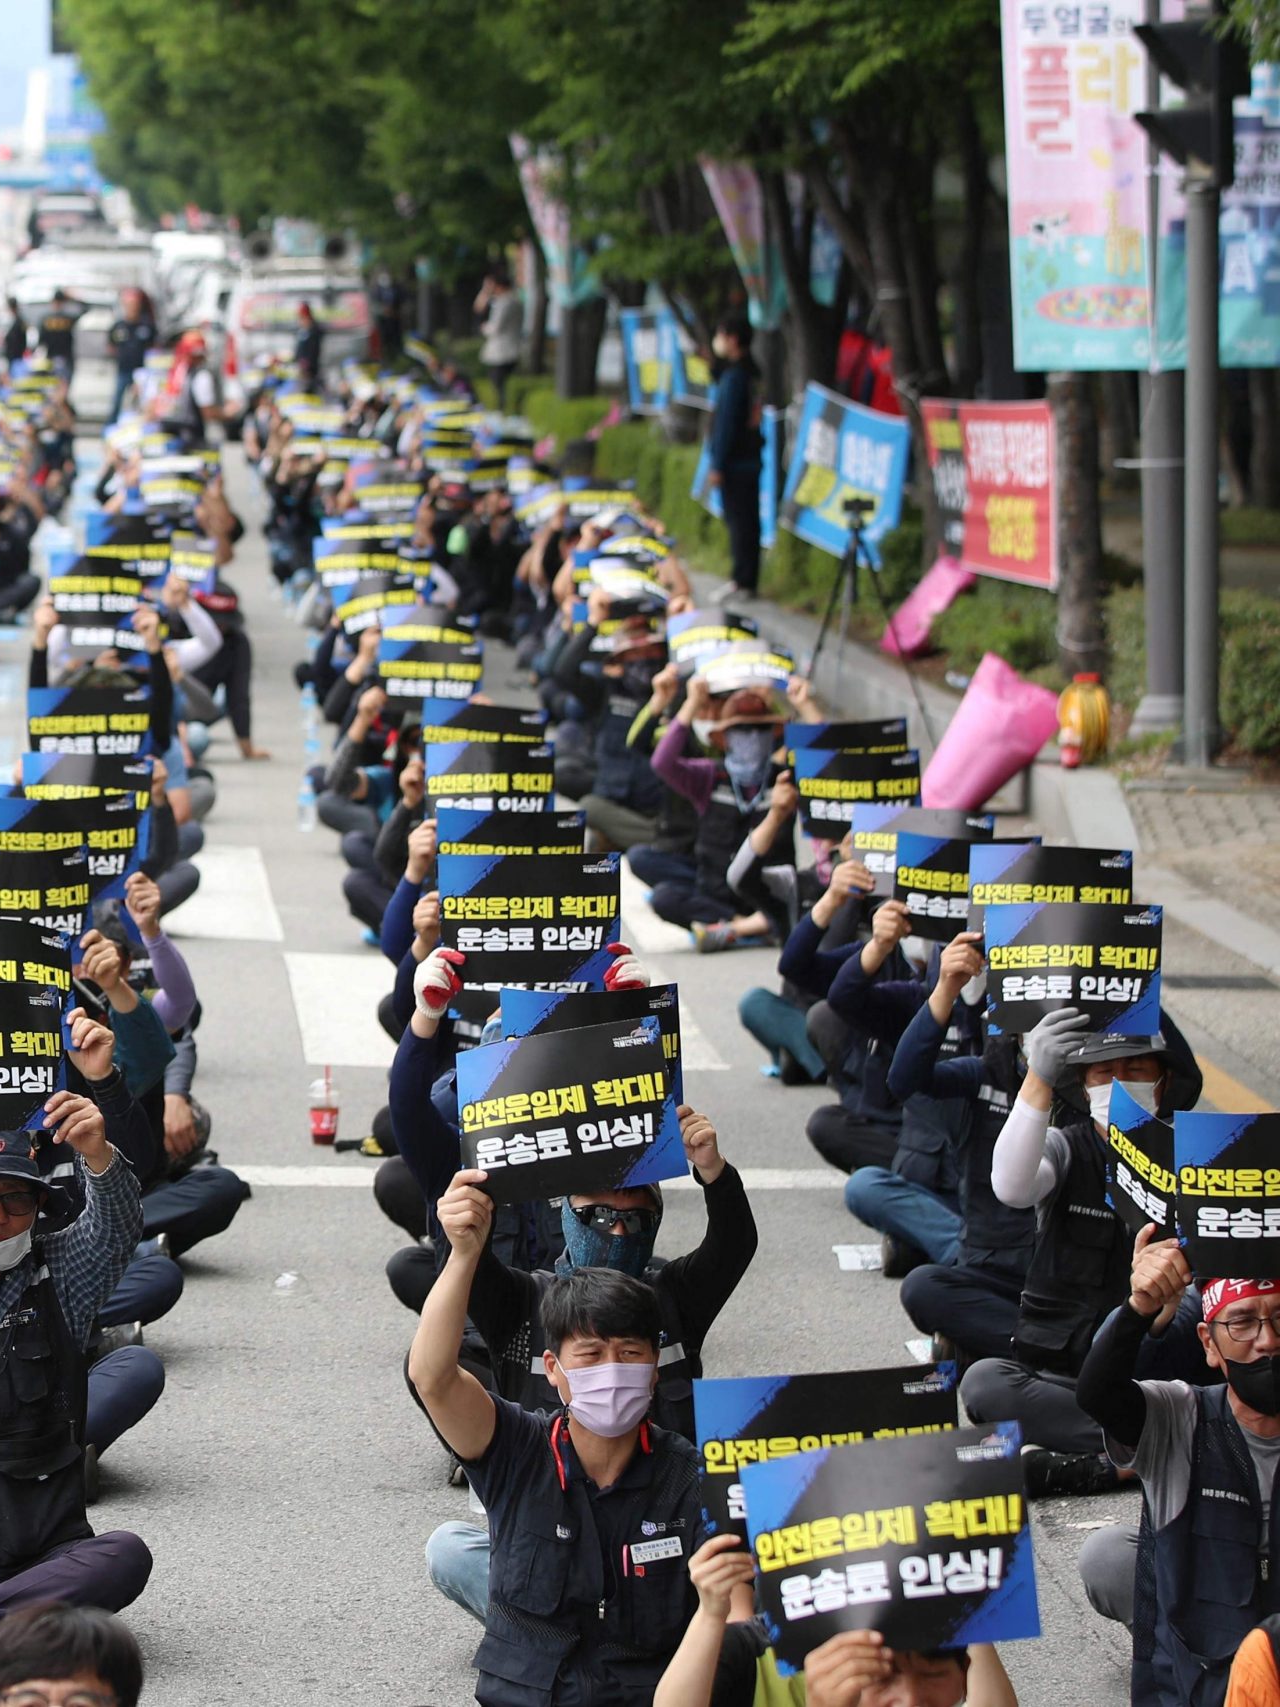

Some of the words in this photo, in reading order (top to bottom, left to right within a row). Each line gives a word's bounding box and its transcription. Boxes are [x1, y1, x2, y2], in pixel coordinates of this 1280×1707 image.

[88, 828, 135, 849] 확대!
[88, 855, 124, 874] 상!
[898, 867, 969, 892] 안전운임
[46, 884, 88, 907] 확대!
[973, 883, 1074, 904] 안전운임제
[443, 897, 553, 919] 안전운임제
[560, 896, 616, 918] 확대!
[457, 928, 534, 951] 운송료
[542, 927, 603, 950] 인상!
[989, 944, 1093, 970] 안전운임제
[1099, 946, 1157, 970] 확대!
[24, 962, 70, 991] 확대!
[1002, 975, 1072, 1001] 운송료
[1080, 976, 1141, 1001] 인상!
[12, 1031, 59, 1056] 확대!
[464, 1085, 587, 1133] 안전운임제
[593, 1072, 664, 1106] 확대!
[476, 1128, 571, 1170] 운송료
[577, 1113, 653, 1153] 인상!
[1117, 1162, 1167, 1225] 운송료
[1180, 1167, 1280, 1197] 안전운임
[756, 1508, 918, 1572] 안전운임제
[925, 1494, 1021, 1539] 확대!
[781, 1559, 890, 1620] 운송료
[899, 1548, 1001, 1597] 인상!
